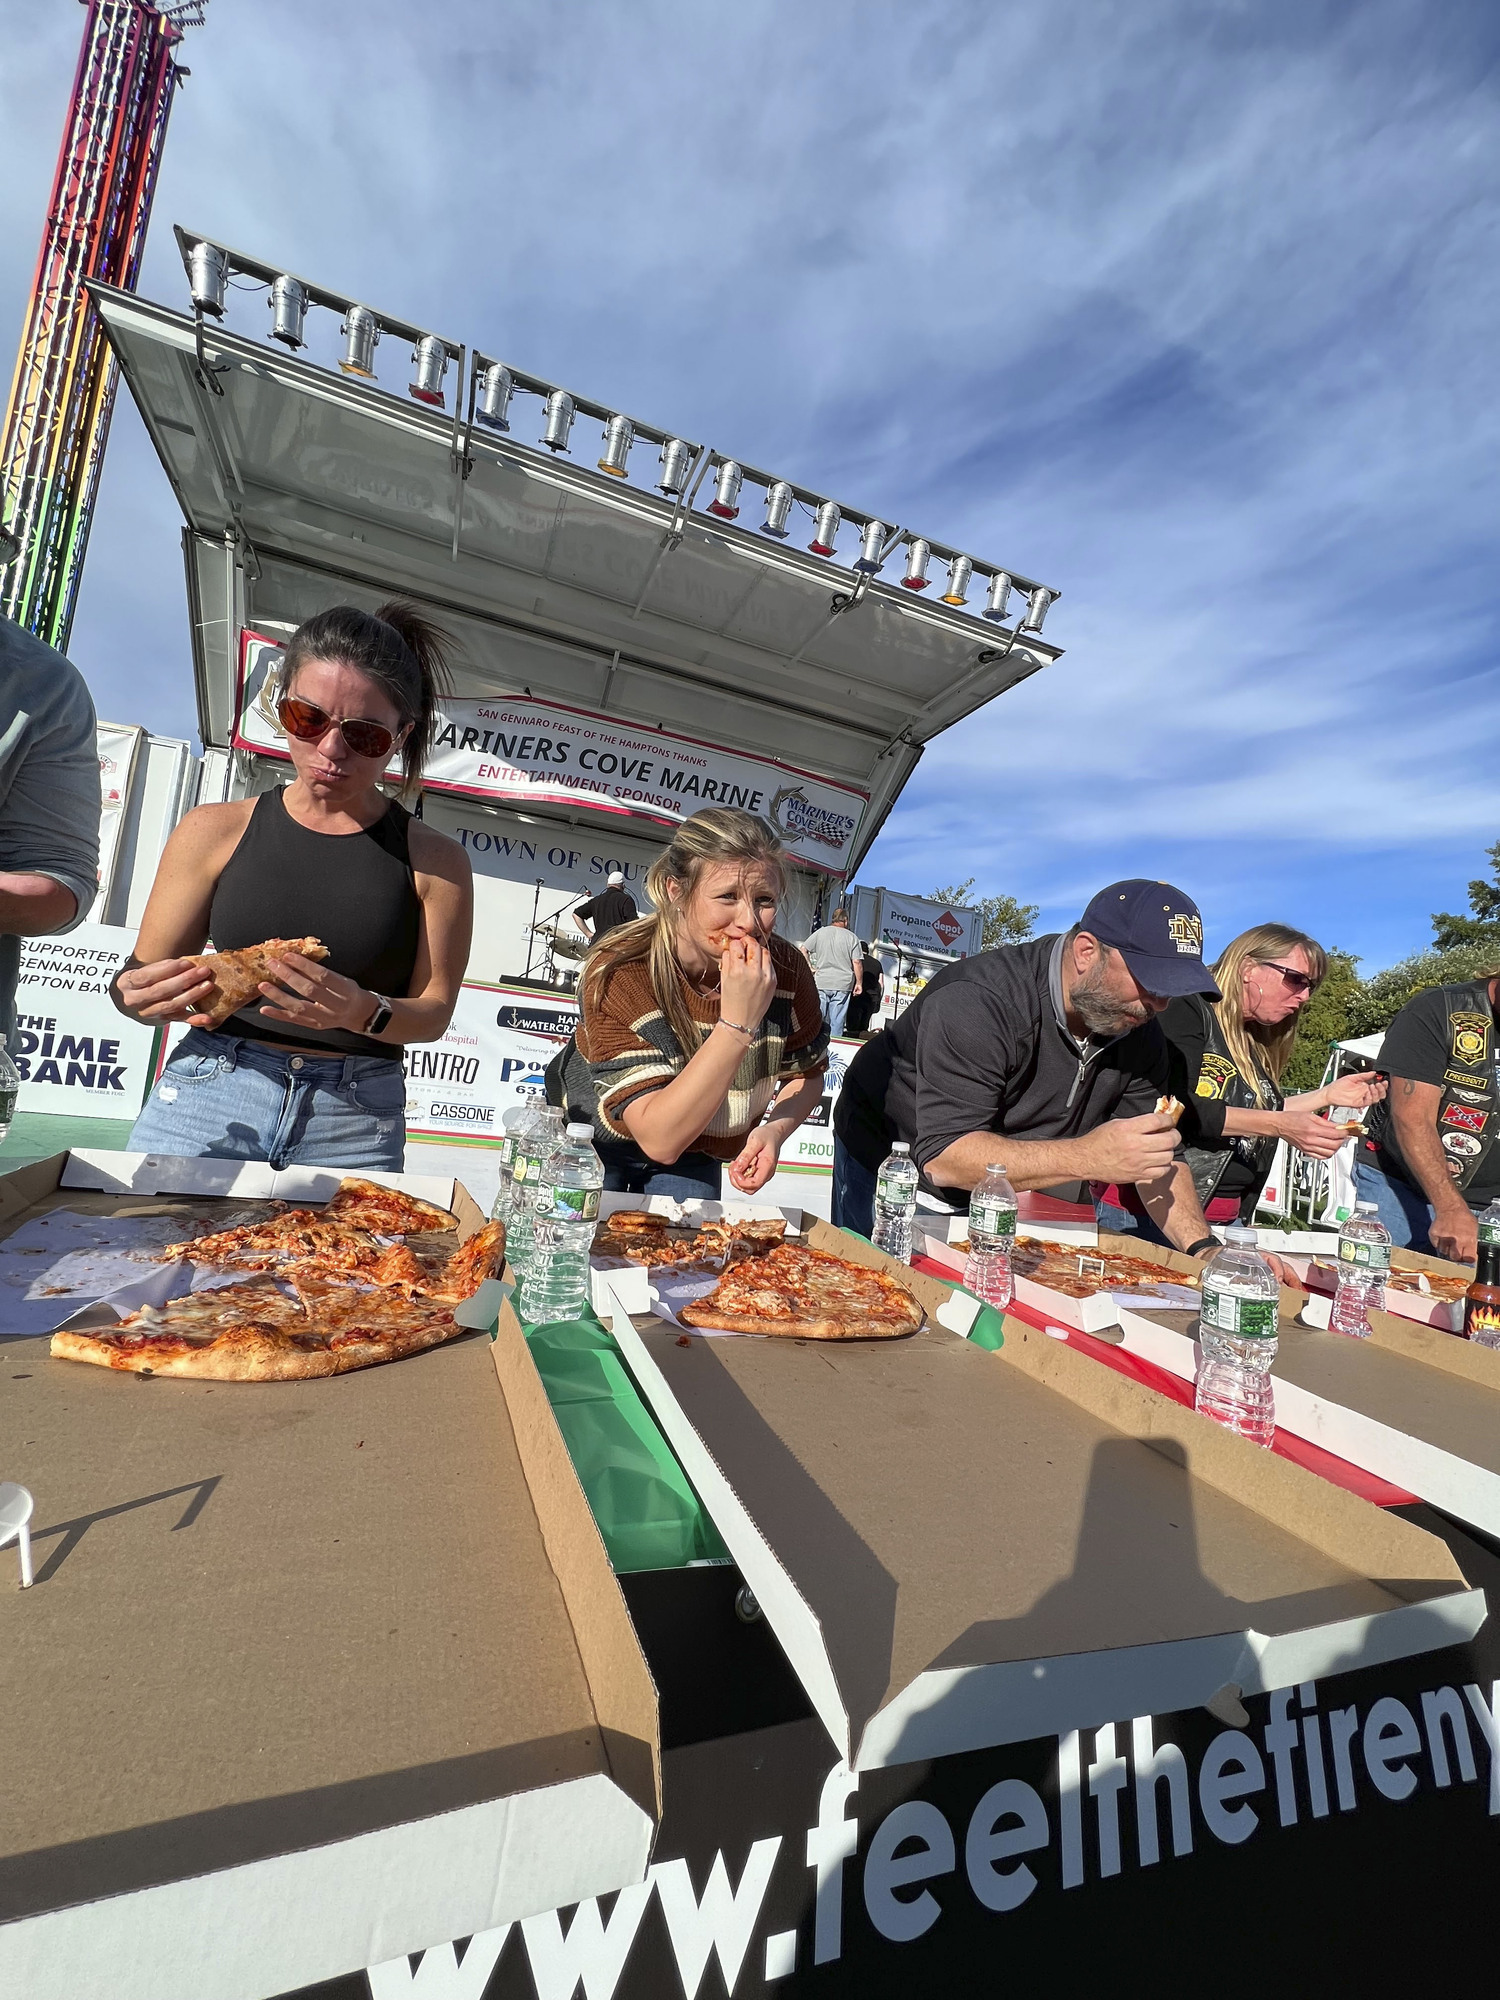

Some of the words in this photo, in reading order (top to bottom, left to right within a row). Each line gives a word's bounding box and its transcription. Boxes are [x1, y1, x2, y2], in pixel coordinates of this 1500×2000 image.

[477, 708, 499, 720] SAN
[500, 712, 550, 728] GENNARO
[552, 722, 582, 736] FEAST
[583, 730, 597, 740] OF
[599, 733, 617, 745] THE
[618, 738, 671, 758] HAMPTONS
[672, 752, 708, 768] THANKS
[432, 720, 571, 763] ARINERS
[578, 749, 654, 783] COVE
[659, 767, 764, 812] MARINE
[477, 763, 611, 795] ENTERTAINMENT
[613, 785, 681, 813] SPONSOR
[787, 797, 855, 829] MARINER'S
[787, 810, 816, 831] COVE
[456, 828, 539, 861] TOWN
[547, 847, 582, 870] OF
[889, 928, 903, 936] Why
[891, 911, 931, 928] Propane
[933, 920, 961, 934] depot
[20, 940, 120, 964] SUPPORTER
[903, 940, 924, 949] BRONZE
[925, 945, 949, 954] SPONSOR
[19, 956, 98, 977] GENNARO
[16, 1014, 57, 1031] THE
[15, 1030, 120, 1064] DIME
[440, 1032, 479, 1045] Hospital
[14, 1056, 128, 1091] BANK
[1449, 1072, 1484, 1086] PRESIDENT
[430, 1103, 495, 1122] CASSONE
